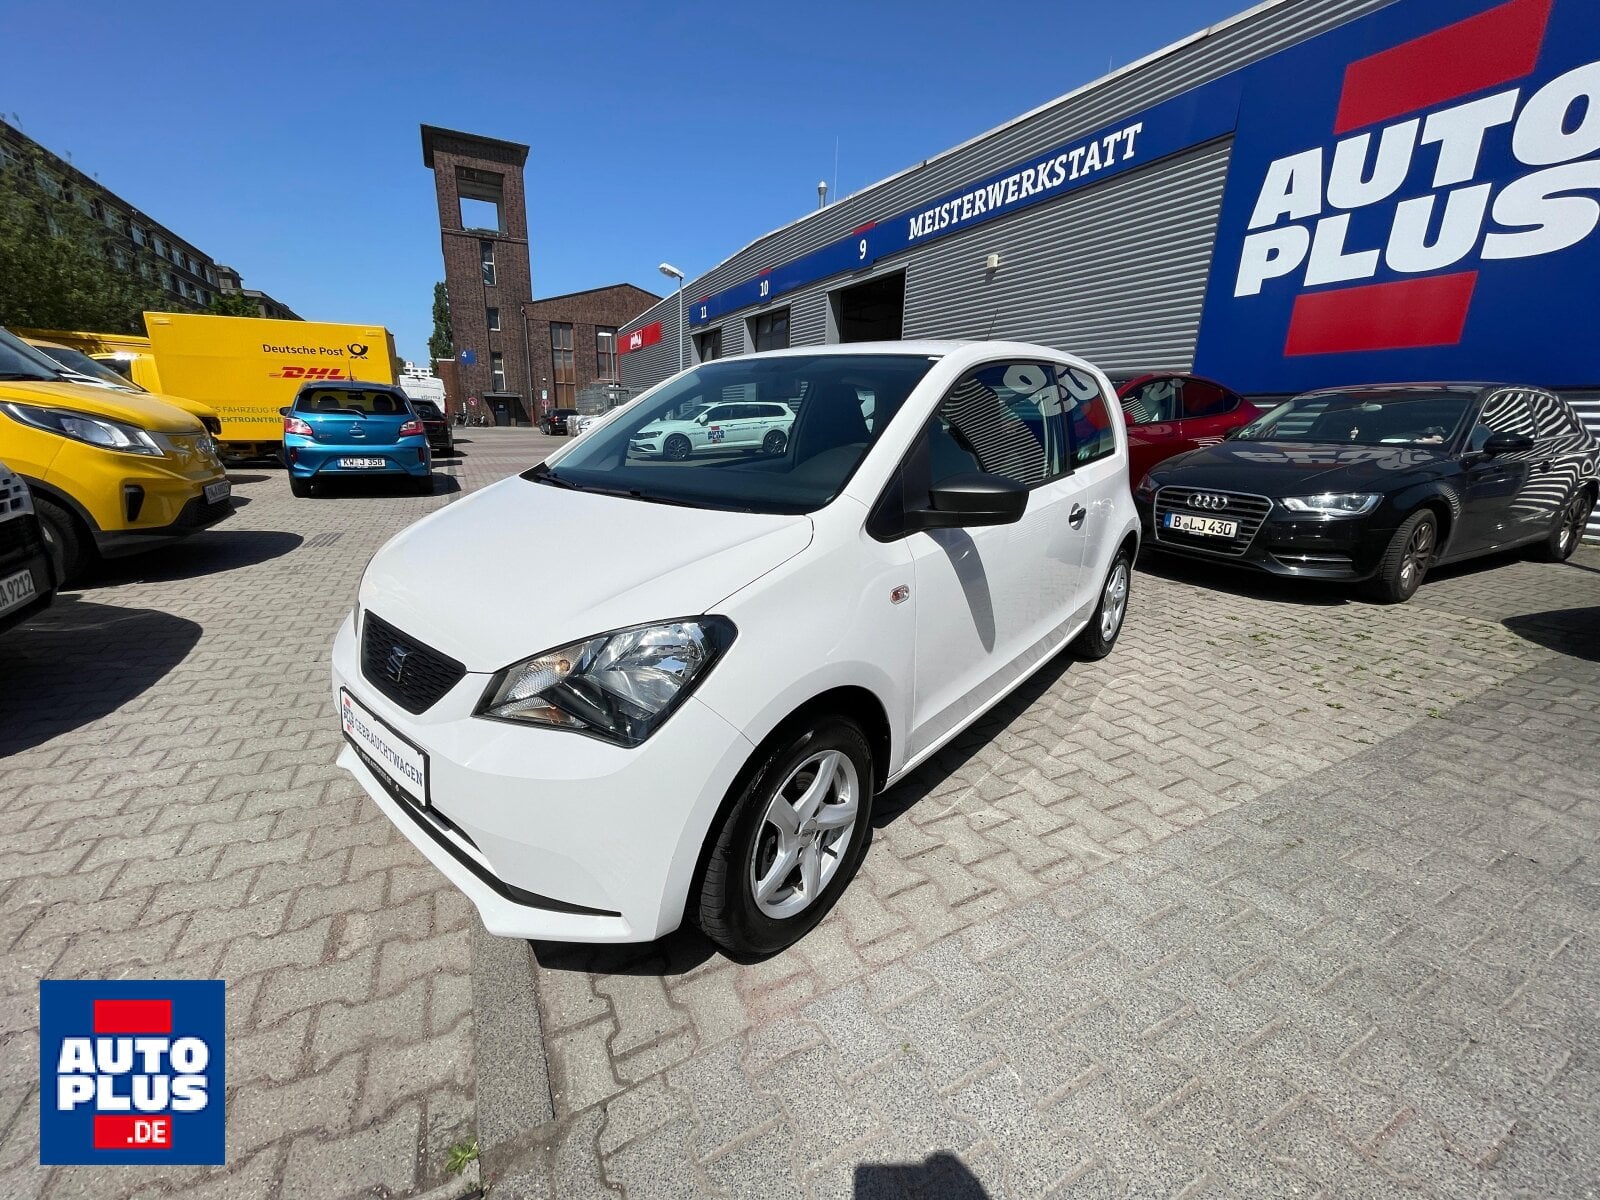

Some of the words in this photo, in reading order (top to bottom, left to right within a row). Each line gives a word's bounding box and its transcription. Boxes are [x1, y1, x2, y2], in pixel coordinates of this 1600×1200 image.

[1247, 61, 1600, 230] AUTO
[908, 122, 1143, 240] MEISTERWERKSTATT
[1234, 160, 1600, 297] PLUS
[859, 239, 867, 260] 9
[760, 280, 769, 297] 10
[700, 305, 707, 319] 11
[262, 344, 316, 355] Deutsche
[319, 346, 344, 356] Post
[281, 366, 346, 380] DHL
[1174, 516, 1182, 528] B
[1190, 518, 1206, 531] LJ
[1208, 521, 1232, 535] 430
[7, 573, 34, 602] 9212
[355, 718, 423, 787] GEBRAUCHTWAGEN
